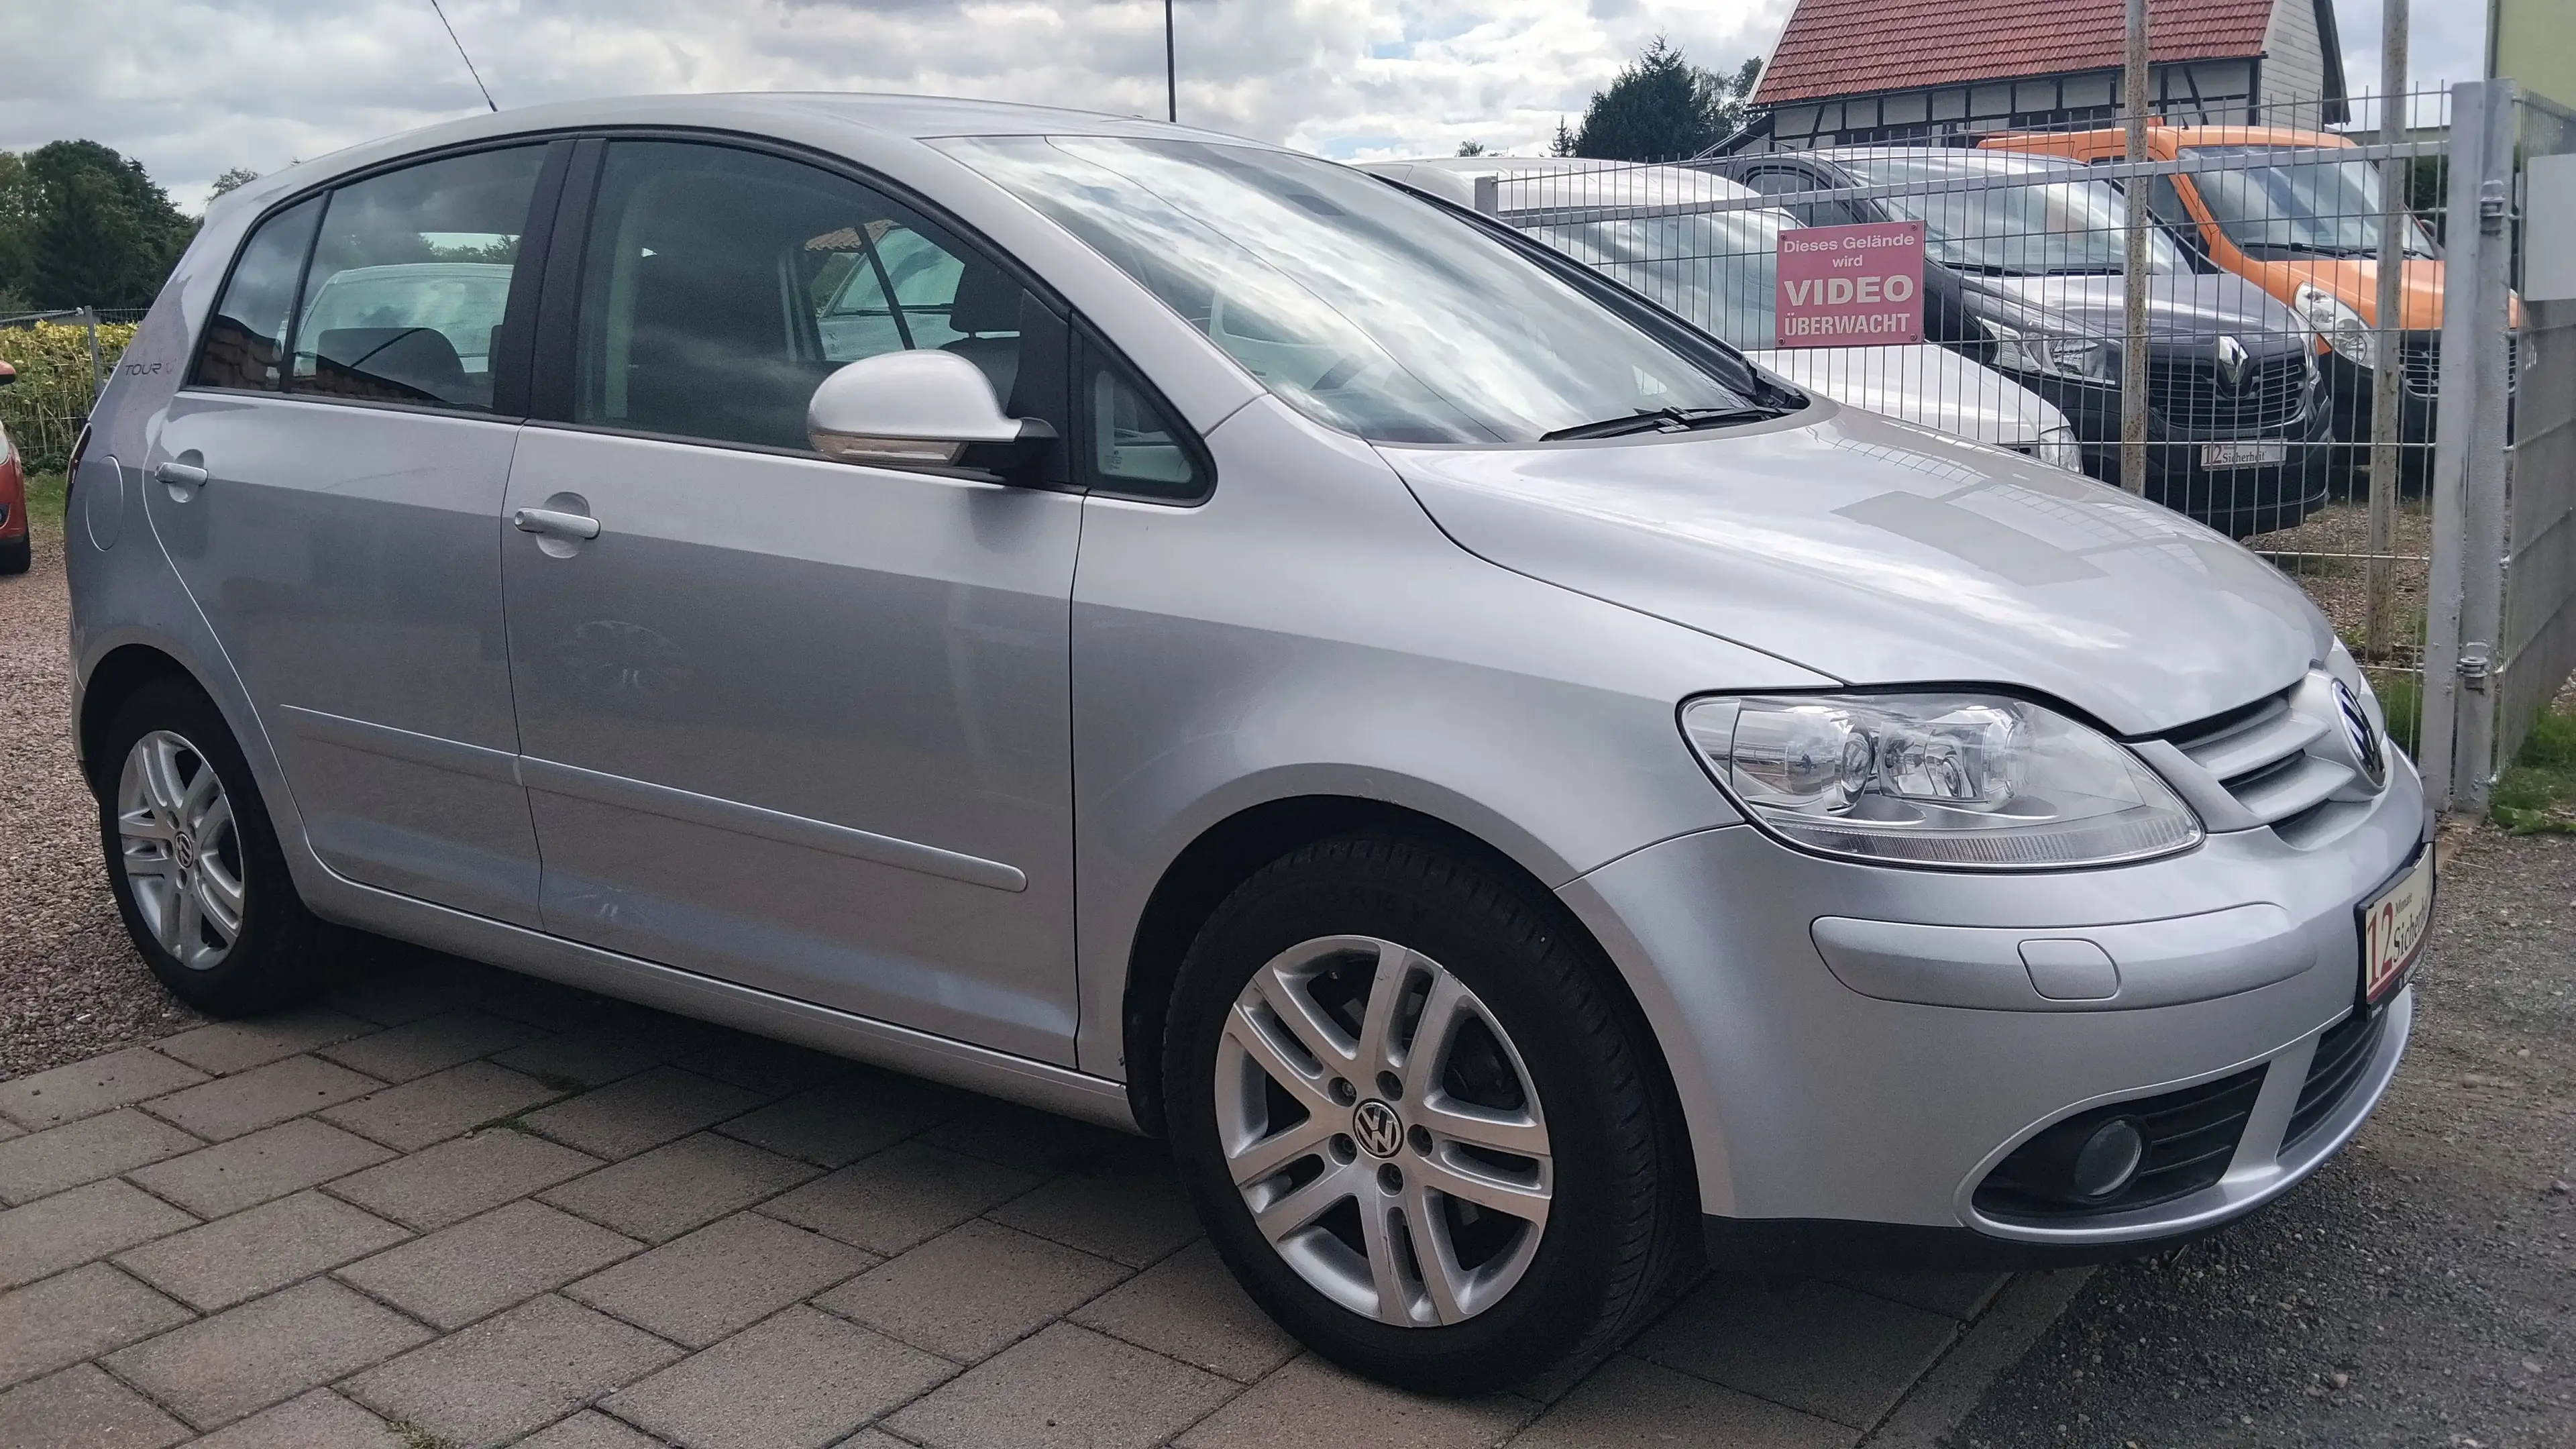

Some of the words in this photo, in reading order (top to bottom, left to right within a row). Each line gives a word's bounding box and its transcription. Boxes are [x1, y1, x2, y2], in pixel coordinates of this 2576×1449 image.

[1784, 239, 1838, 253] Dieses
[1843, 234, 1915, 250] Gelände
[1832, 255, 1863, 268] wird
[1784, 274, 1913, 307] VIDEO
[1784, 312, 1911, 336] ÜBERWACHT
[125, 363, 162, 376] TOUR
[2204, 443, 2222, 464] 12
[2367, 902, 2394, 990] 12
